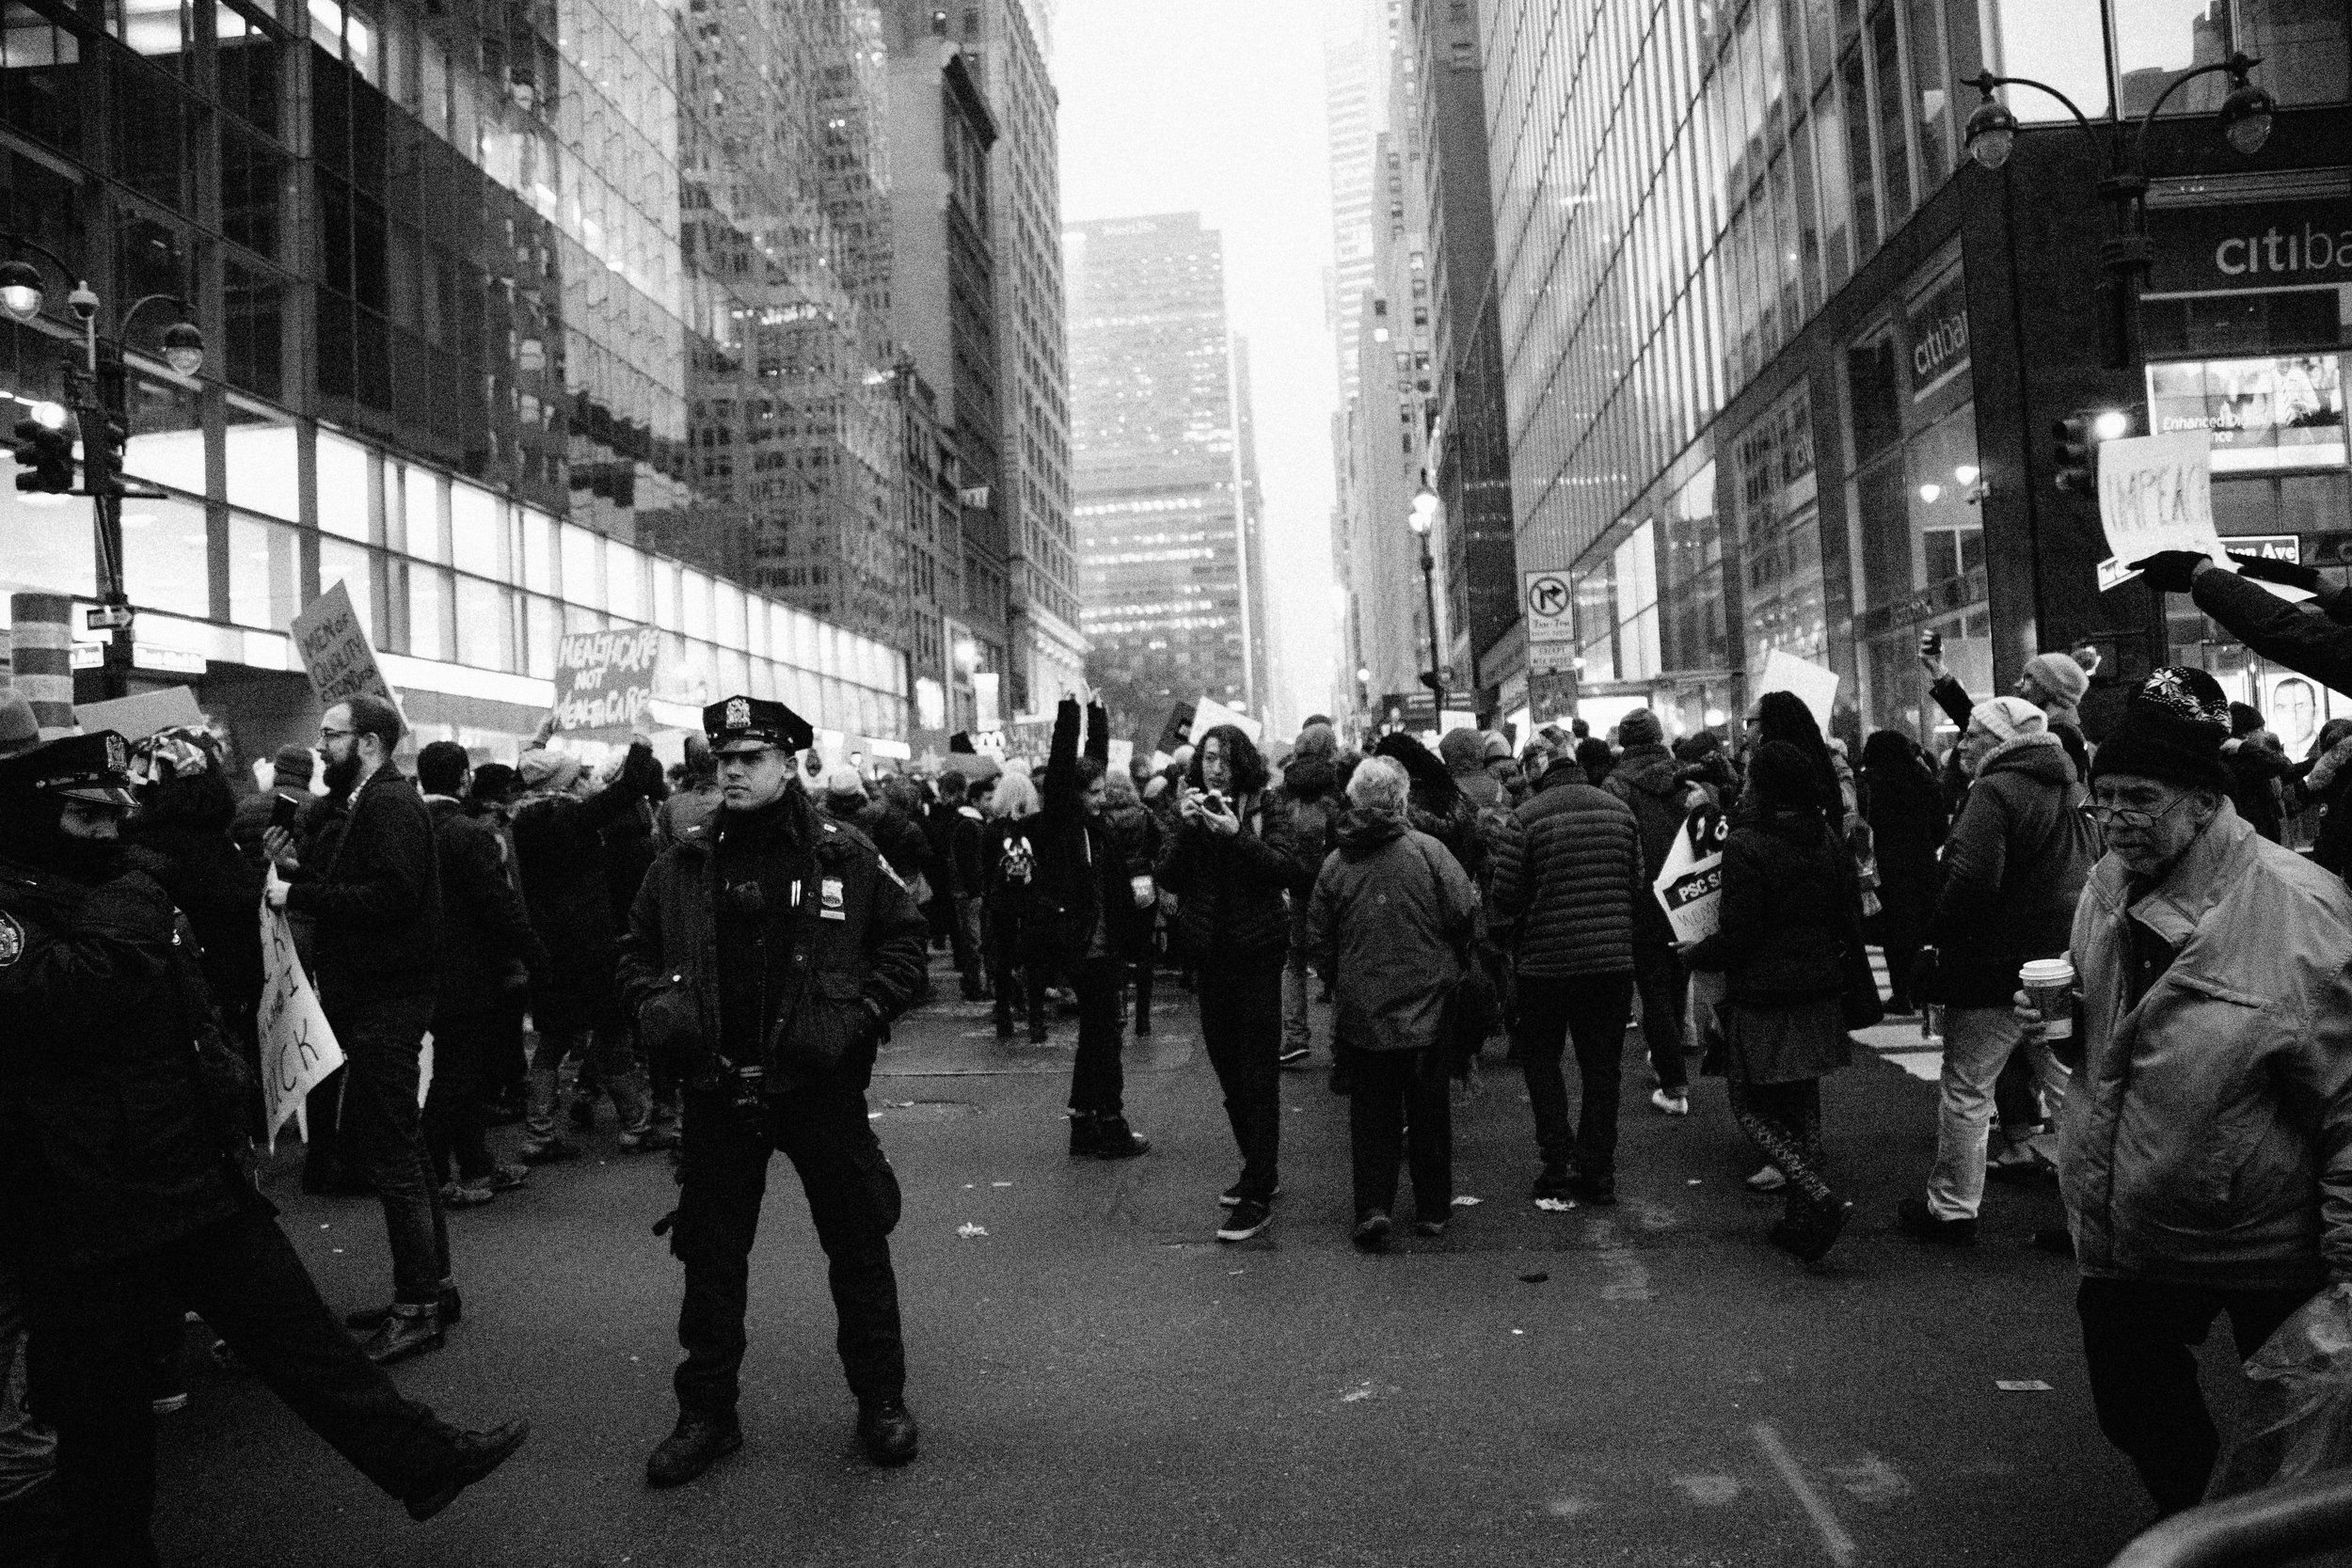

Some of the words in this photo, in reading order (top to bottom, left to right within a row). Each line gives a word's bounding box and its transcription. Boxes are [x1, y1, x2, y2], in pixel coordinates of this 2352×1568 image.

[2163, 414, 2227, 430] Enhanced
[2262, 543, 2296, 561] Ave
[574, 668, 607, 691] NOT
[1677, 879, 1708, 902] PSC
